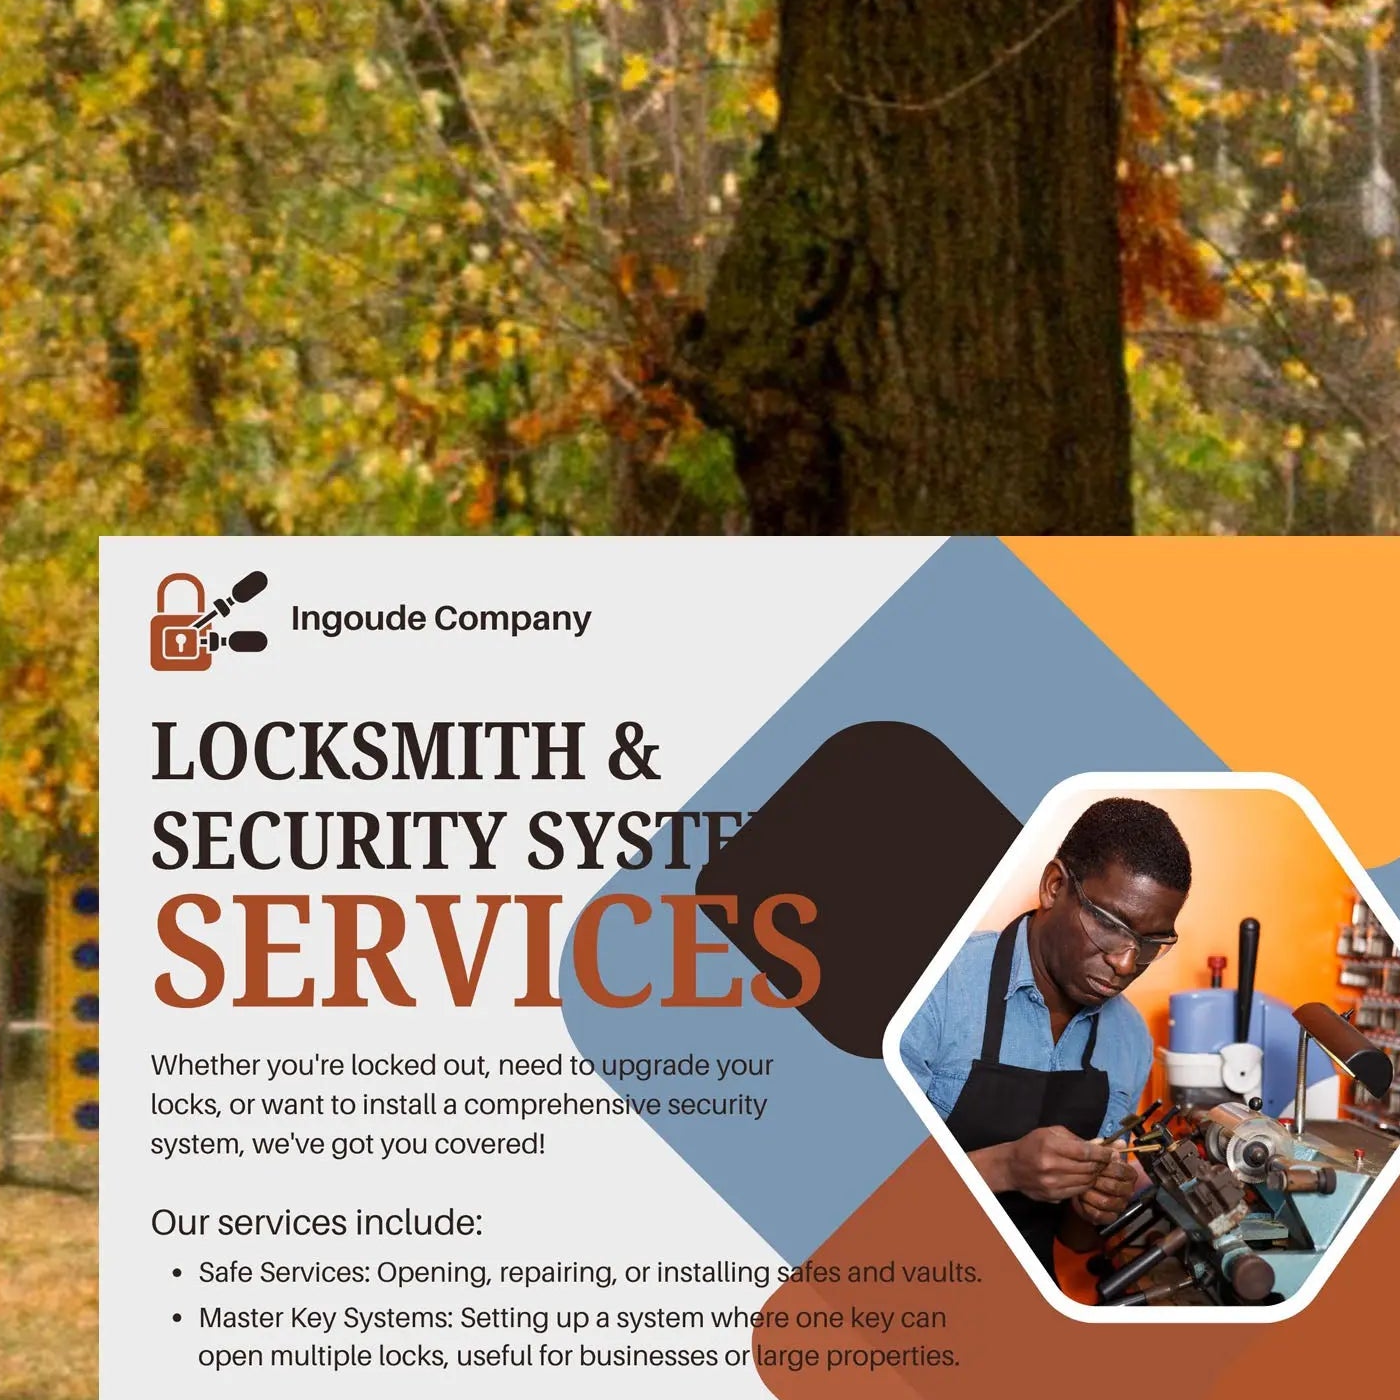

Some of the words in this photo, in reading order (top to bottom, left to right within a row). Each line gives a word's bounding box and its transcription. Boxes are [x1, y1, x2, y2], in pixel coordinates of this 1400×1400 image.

[293, 604, 426, 637] Ingoude
[435, 605, 592, 637] Company
[152, 721, 585, 780] LOCKSMITH
[608, 721, 661, 780] &
[152, 811, 507, 870] SECURITY
[154, 893, 821, 1009] SERVICES
[151, 1053, 260, 1075] Whether
[267, 1053, 344, 1081] you're
[352, 1053, 435, 1075] locked
[444, 1056, 490, 1078] out,
[500, 1053, 562, 1075] need
[569, 1050, 595, 1076] to
[602, 1053, 711, 1083] upgrade
[716, 1059, 774, 1081] your
[152, 1093, 221, 1118] locks,
[230, 1098, 255, 1115] or
[261, 1095, 324, 1115] want
[331, 1095, 356, 1115] to
[364, 1093, 437, 1115] install
[444, 1098, 456, 1115] a
[464, 1090, 661, 1121] comprehensive
[668, 1094, 768, 1120] security
[151, 1135, 244, 1160] system,
[252, 1132, 324, 1154] we've
[332, 1135, 374, 1160] got
[380, 1138, 426, 1160] you
[435, 1132, 544, 1154] covered!
[152, 1209, 210, 1235] Our
[218, 1209, 346, 1235] services
[357, 1208, 482, 1235] include:
[200, 1260, 252, 1282] Safe
[260, 1262, 369, 1282] Services:
[377, 1262, 491, 1288] Opening,
[501, 1262, 617, 1288] repairing,
[625, 1266, 650, 1283] or
[658, 1261, 769, 1288] installing
[776, 1260, 840, 1285] safes
[848, 1260, 894, 1283] and
[901, 1260, 982, 1283] vaults.
[201, 1307, 284, 1328] Master
[292, 1307, 336, 1333] Key
[344, 1307, 452, 1333] Systems:
[461, 1307, 548, 1333] Setting
[557, 1312, 589, 1333] up
[596, 1312, 609, 1328] a
[617, 1309, 703, 1333] system
[711, 1303, 789, 1328] where
[796, 1312, 844, 1328] one
[852, 1306, 894, 1333] key
[901, 1312, 946, 1328] can
[199, 1350, 262, 1371] open
[272, 1344, 372, 1371] multiple
[380, 1344, 448, 1369] locks,
[458, 1344, 533, 1366] useful
[539, 1344, 573, 1366] for
[581, 1344, 718, 1366] businesses
[725, 1350, 750, 1366] or
[757, 1344, 819, 1372] large
[828, 1345, 959, 1372] properties.
